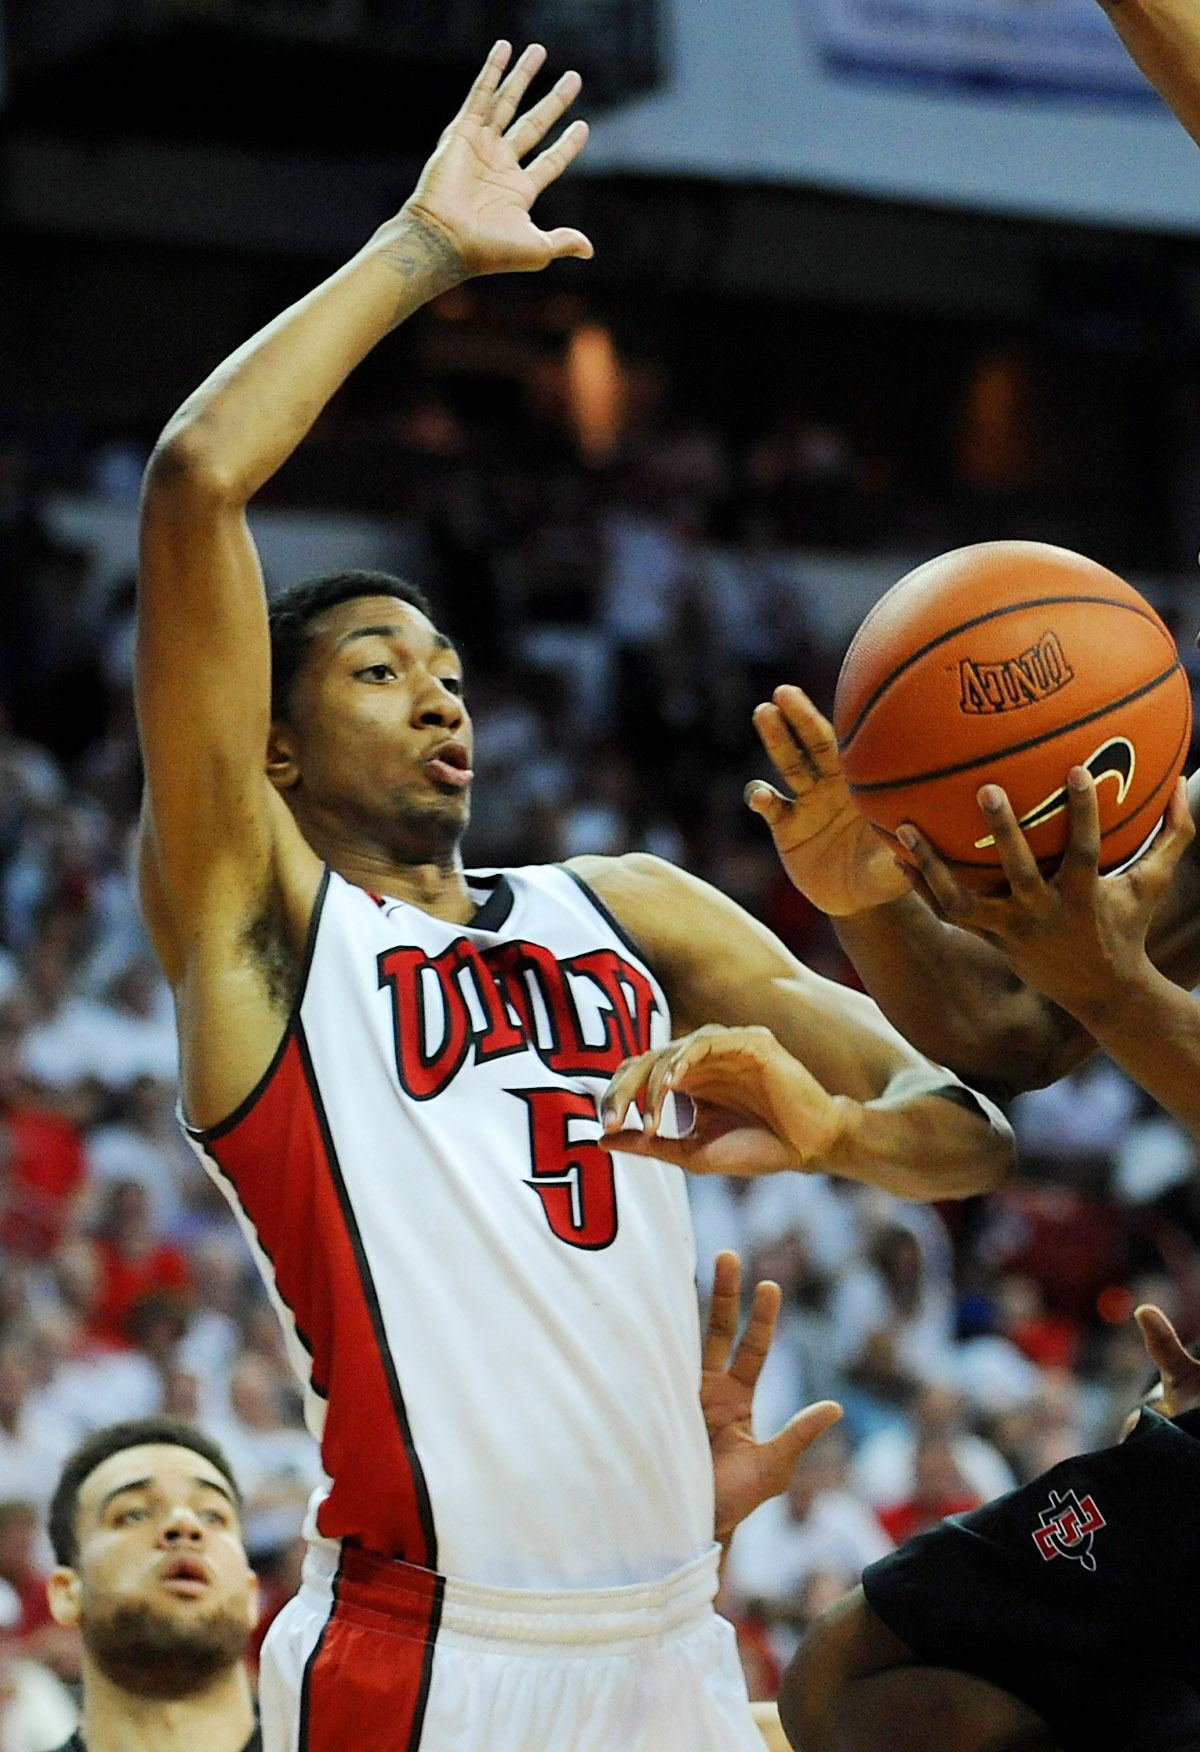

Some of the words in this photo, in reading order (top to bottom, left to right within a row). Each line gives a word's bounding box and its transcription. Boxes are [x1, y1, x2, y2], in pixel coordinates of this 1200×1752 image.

[959, 630, 1075, 715] UNLV
[376, 936, 663, 1112] UNLV
[502, 1087, 619, 1252] 5
